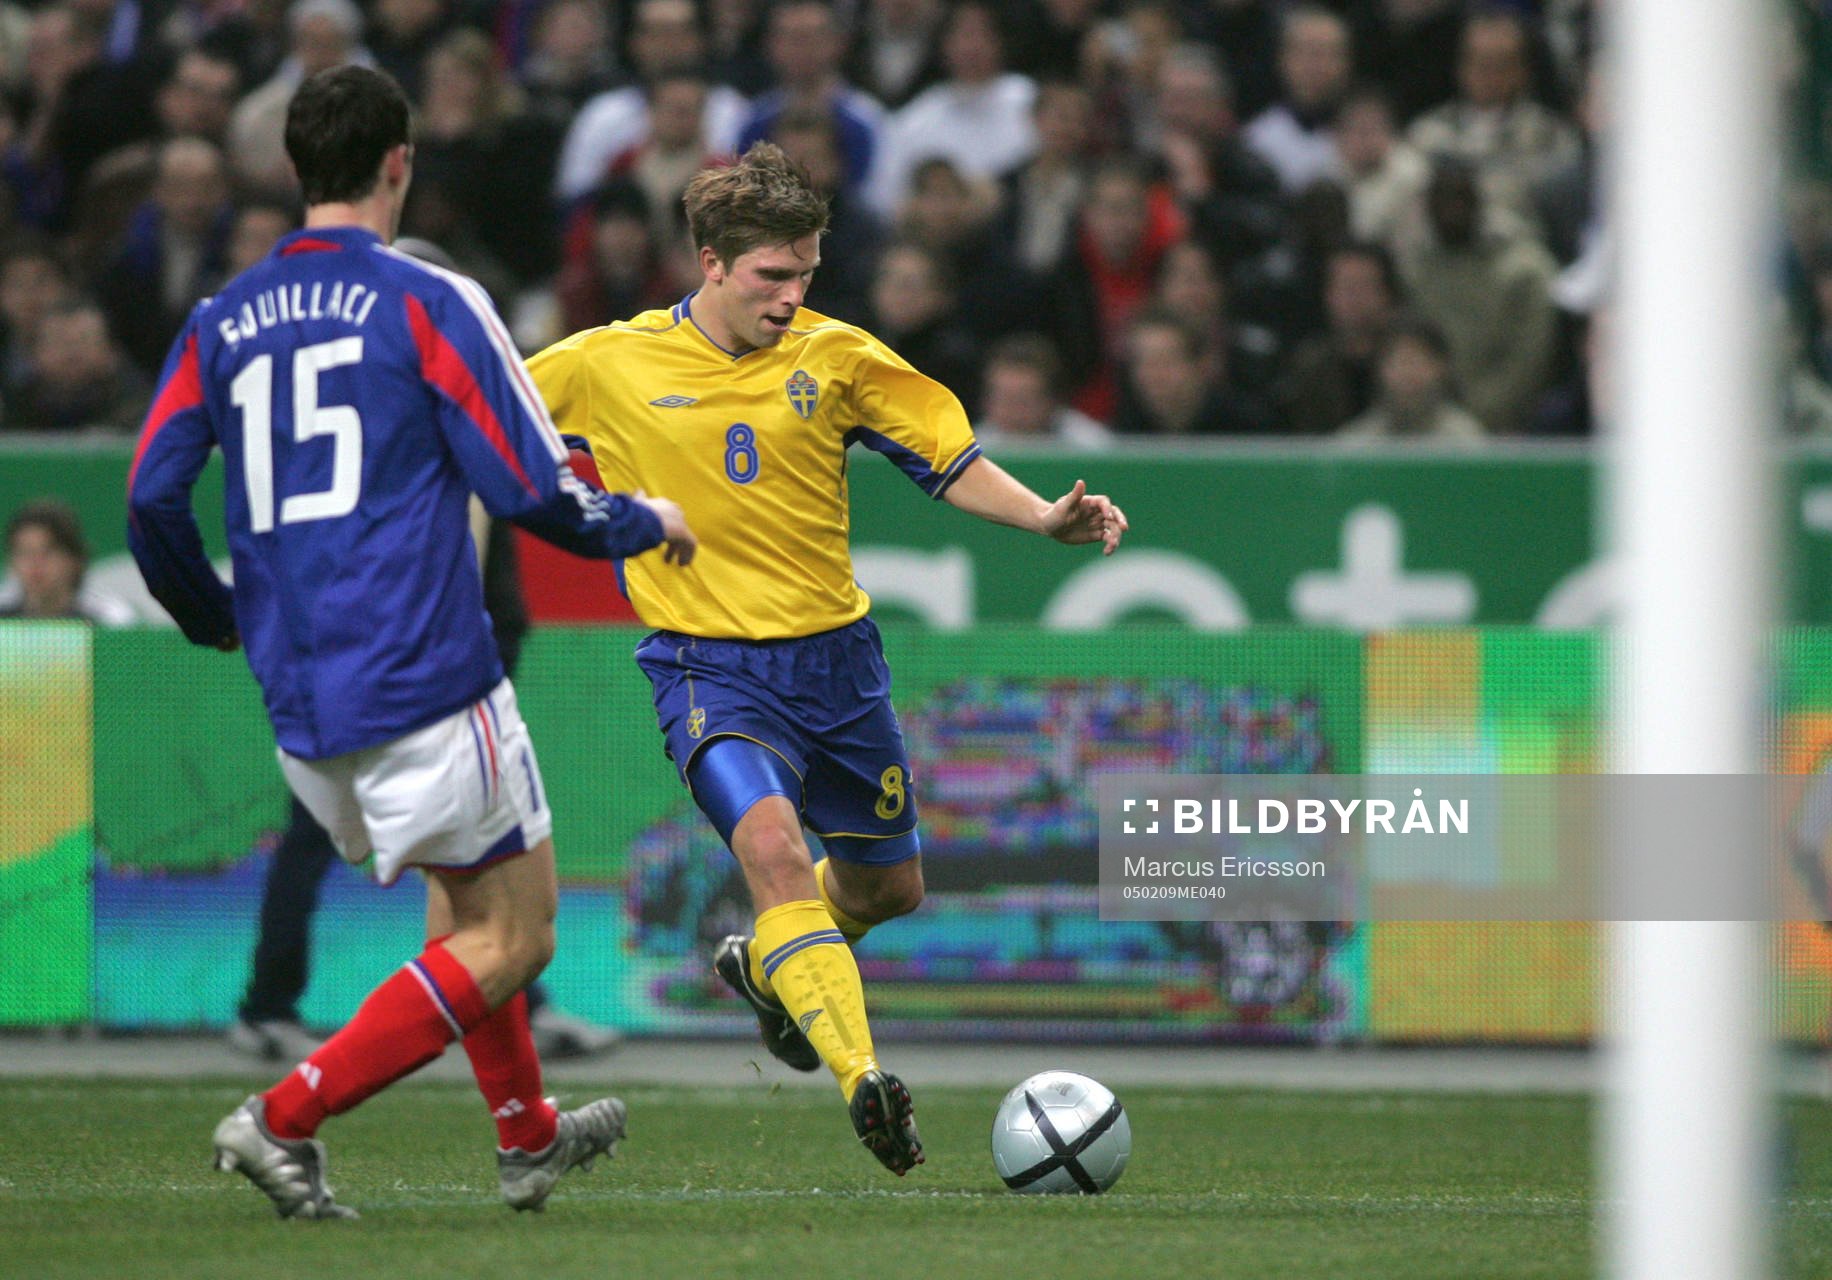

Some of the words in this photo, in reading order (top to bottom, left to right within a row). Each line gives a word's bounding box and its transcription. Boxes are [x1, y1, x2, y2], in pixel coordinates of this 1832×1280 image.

[230, 335, 363, 534] 15
[724, 422, 760, 484] 8
[874, 765, 905, 820] 8
